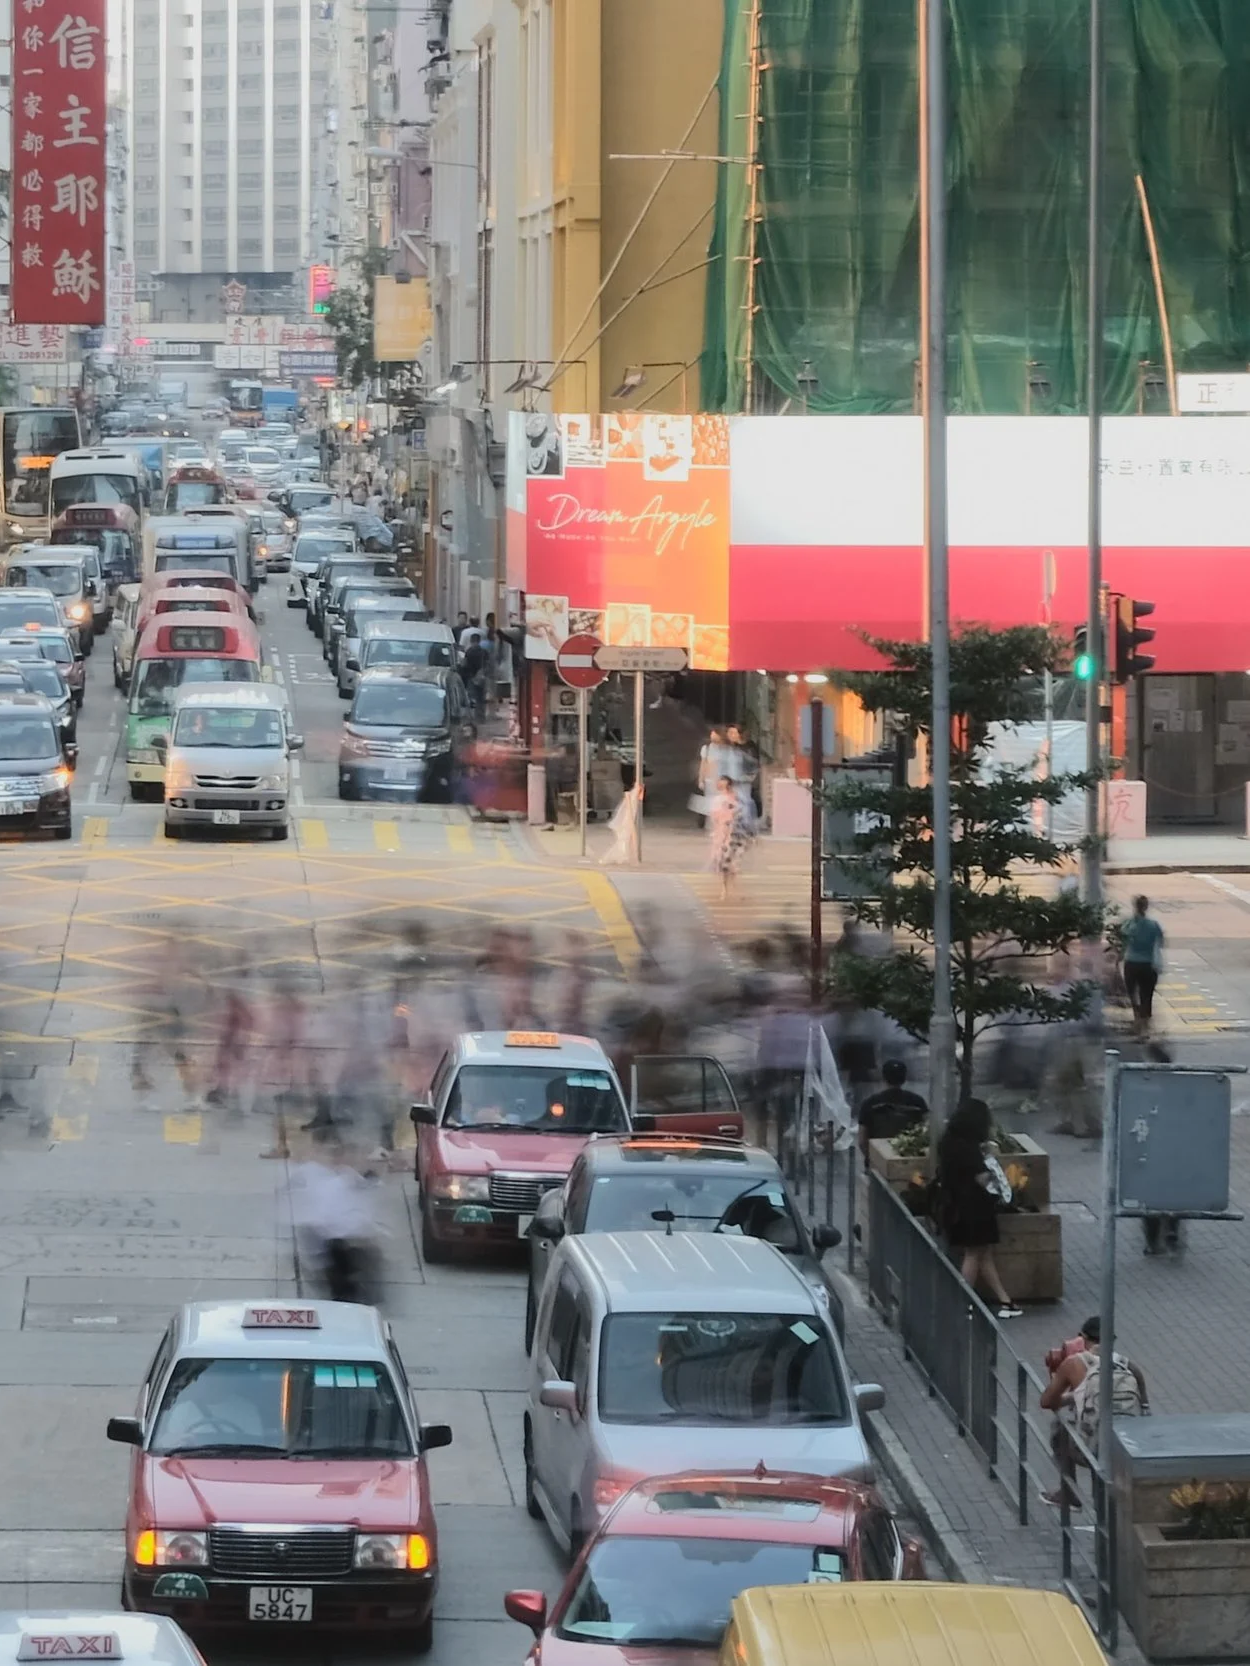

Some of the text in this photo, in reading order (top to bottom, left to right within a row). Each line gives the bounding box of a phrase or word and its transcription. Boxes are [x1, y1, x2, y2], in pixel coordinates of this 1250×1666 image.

[49, 14, 101, 305] 信主耶穌
[537, 494, 717, 555] Dream Argyle
[252, 1309, 315, 1324] TAXI
[268, 1588, 295, 1604] UC
[253, 1603, 308, 1620] 5847
[31, 1636, 113, 1654] TAXI
